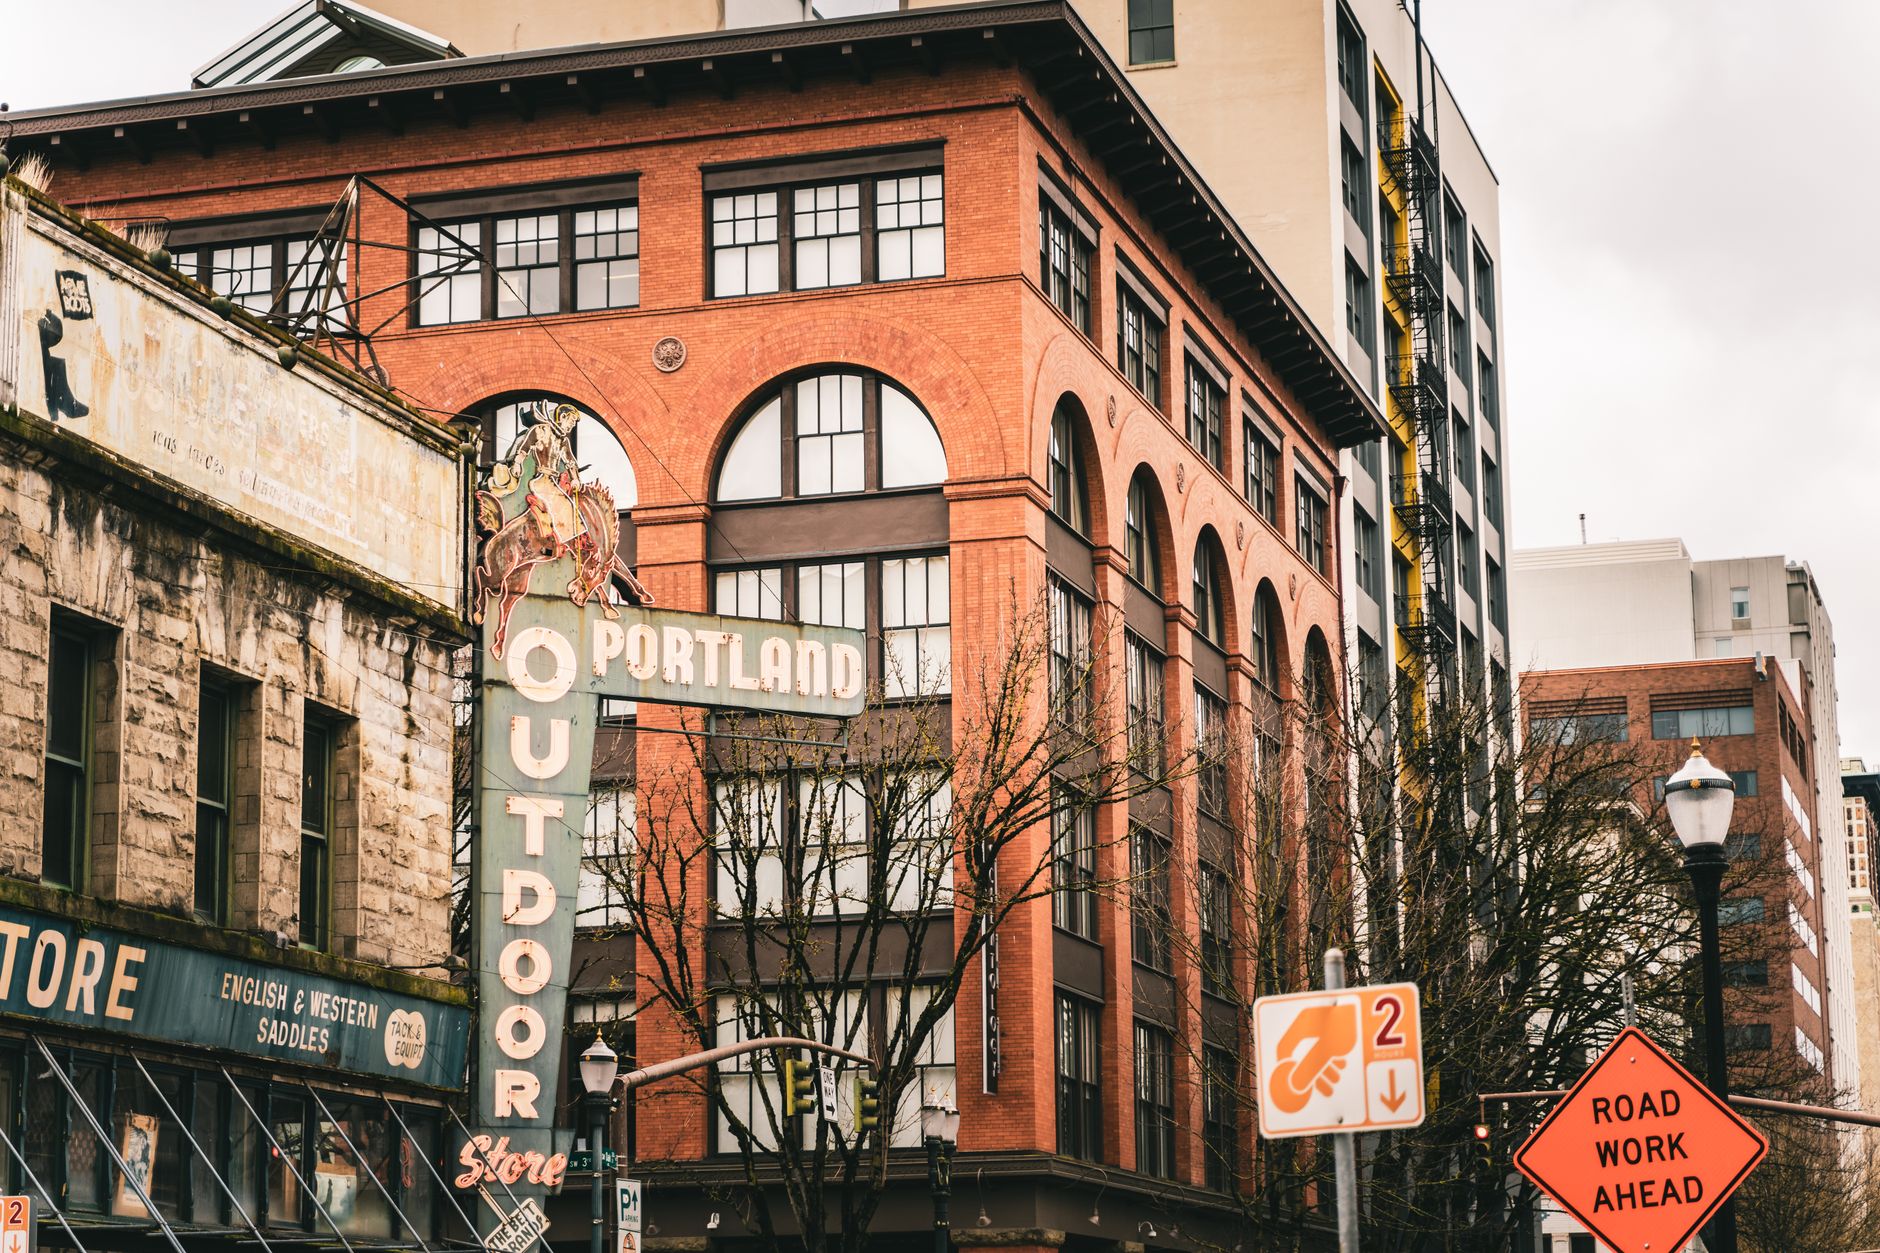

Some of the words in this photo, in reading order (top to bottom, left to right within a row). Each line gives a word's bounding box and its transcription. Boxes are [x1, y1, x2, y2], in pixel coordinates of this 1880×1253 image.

[592, 619, 862, 699] PORTLAND
[495, 626, 578, 1119] OUTDOOR
[0, 920, 147, 1021] TORE
[221, 972, 288, 1011] ENGLISH
[294, 989, 304, 1015] &
[311, 990, 379, 1029] WESTERN
[257, 1017, 330, 1054] SADDLES
[416, 1024, 422, 1040] &
[1374, 996, 1403, 1047] 2
[822, 1071, 833, 1085] ONE
[824, 1086, 835, 1099] WAY
[1592, 1089, 1681, 1125] ROAD
[454, 1134, 568, 1189] Store
[1595, 1132, 1688, 1168] WORK
[10, 1201, 22, 1224] 2
[1593, 1176, 1703, 1213] AHEAD
[509, 1203, 535, 1233] BET
